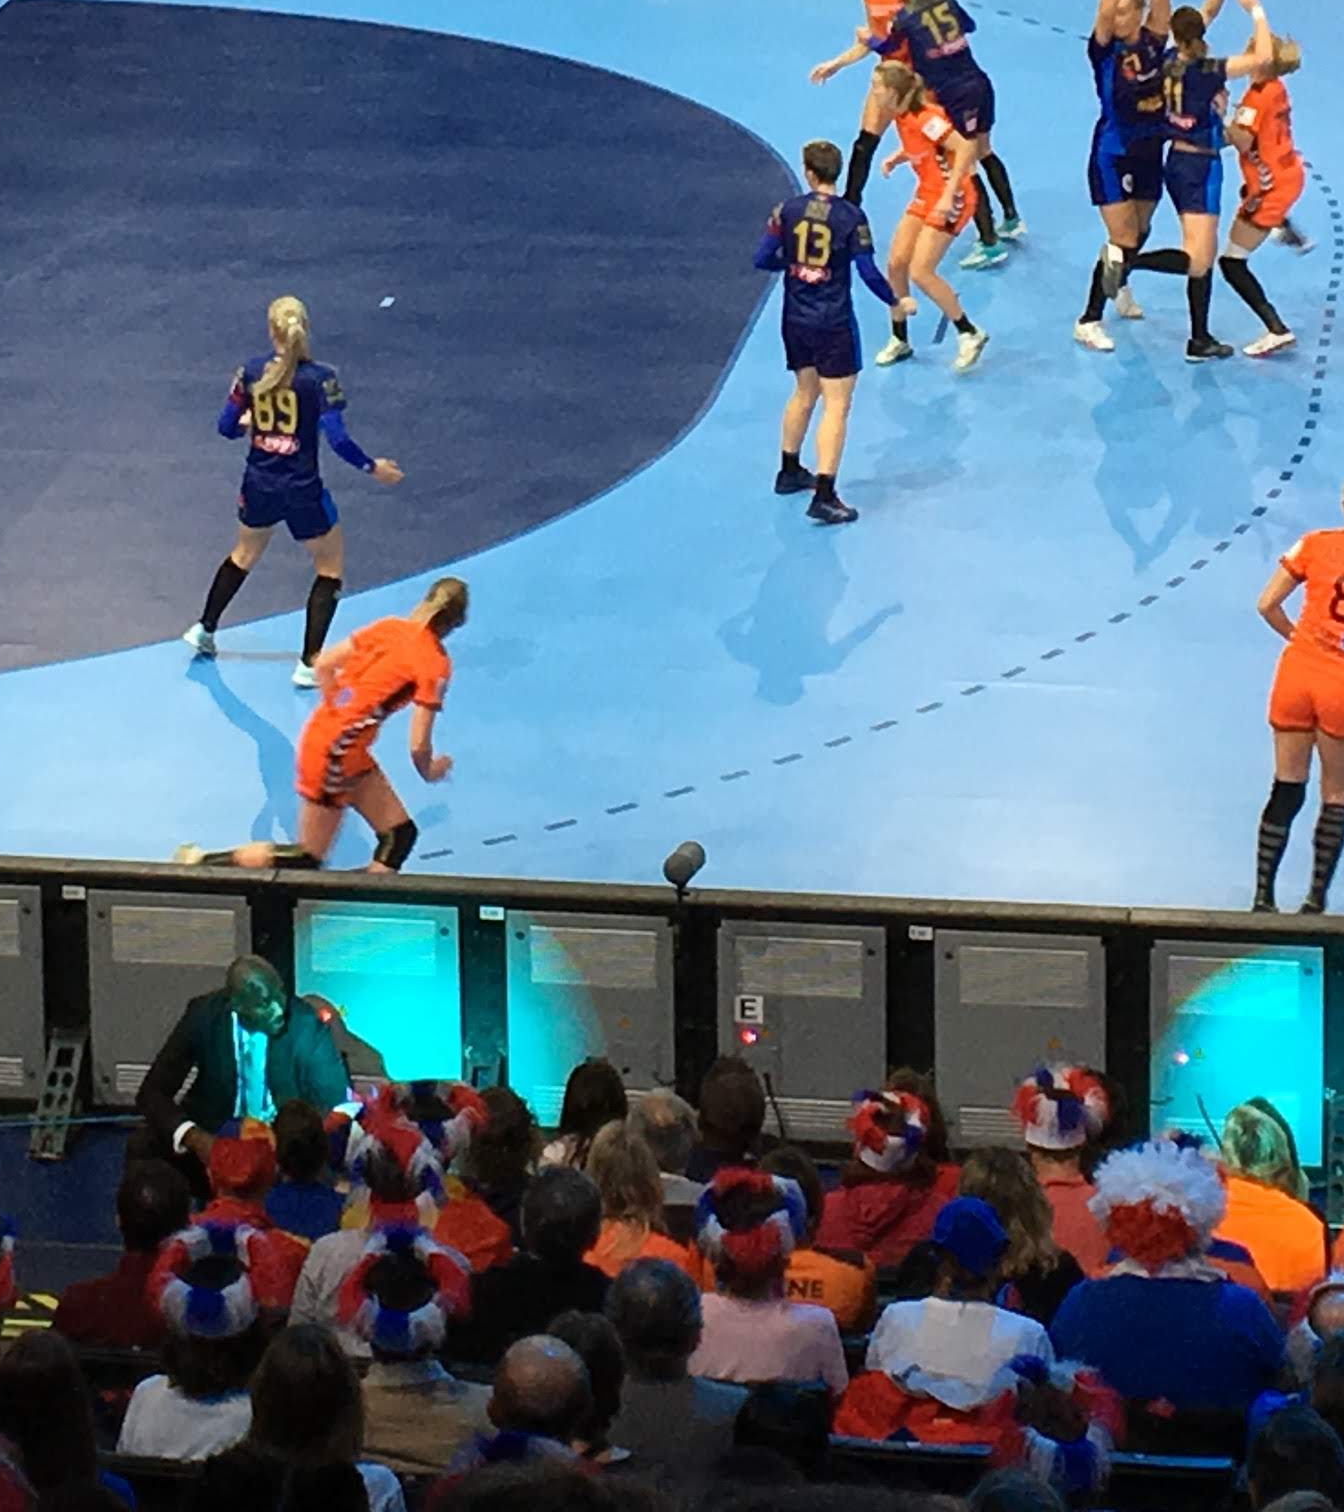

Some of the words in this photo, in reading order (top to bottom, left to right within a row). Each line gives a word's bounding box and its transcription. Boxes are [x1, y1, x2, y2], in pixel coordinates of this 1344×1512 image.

[921, 2, 960, 45] 15
[793, 220, 832, 267] 13
[740, 998, 757, 1019] E
